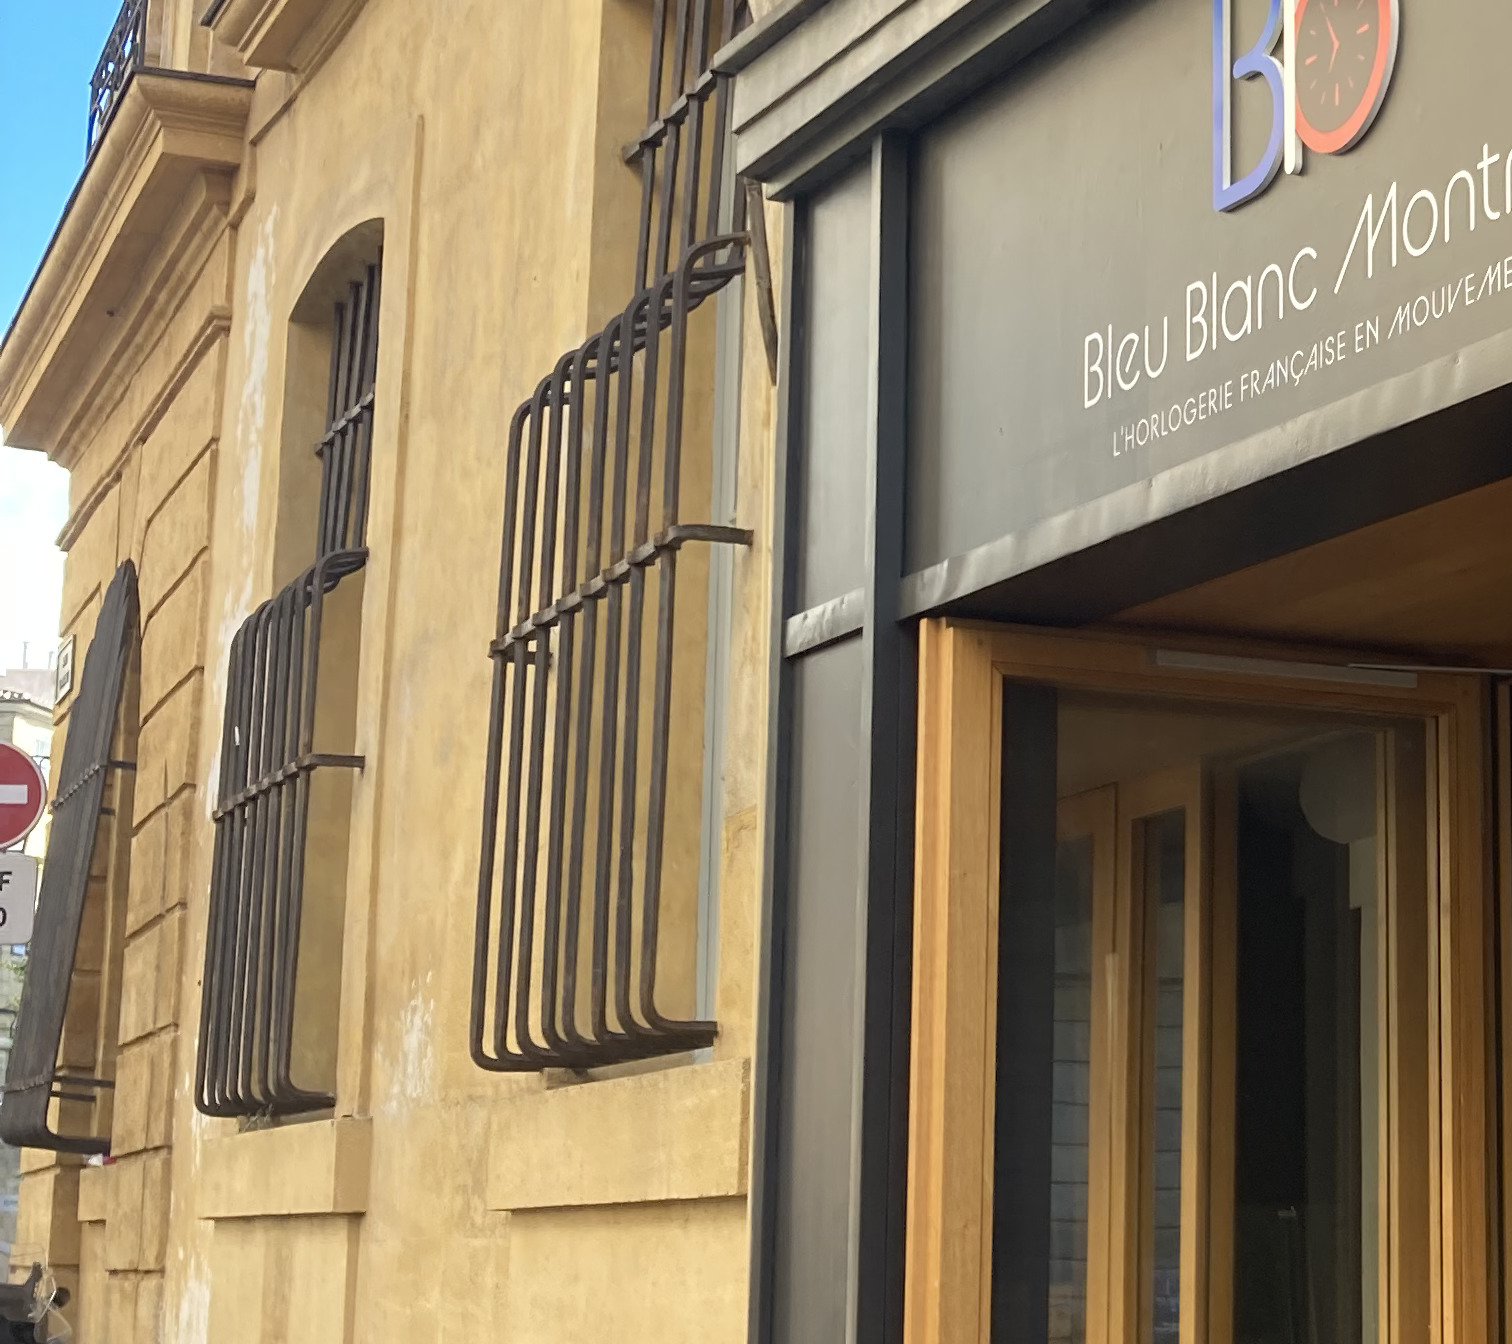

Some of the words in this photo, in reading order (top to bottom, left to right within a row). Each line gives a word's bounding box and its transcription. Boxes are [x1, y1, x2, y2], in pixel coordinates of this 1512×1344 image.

[1082, 316, 1169, 409] Bleu
[1184, 246, 1318, 362] Blanc
[1112, 380, 1233, 457] L'HORLOGERIE
[1238, 329, 1347, 403] FRANÇAISE
[1353, 315, 1380, 354] EN
